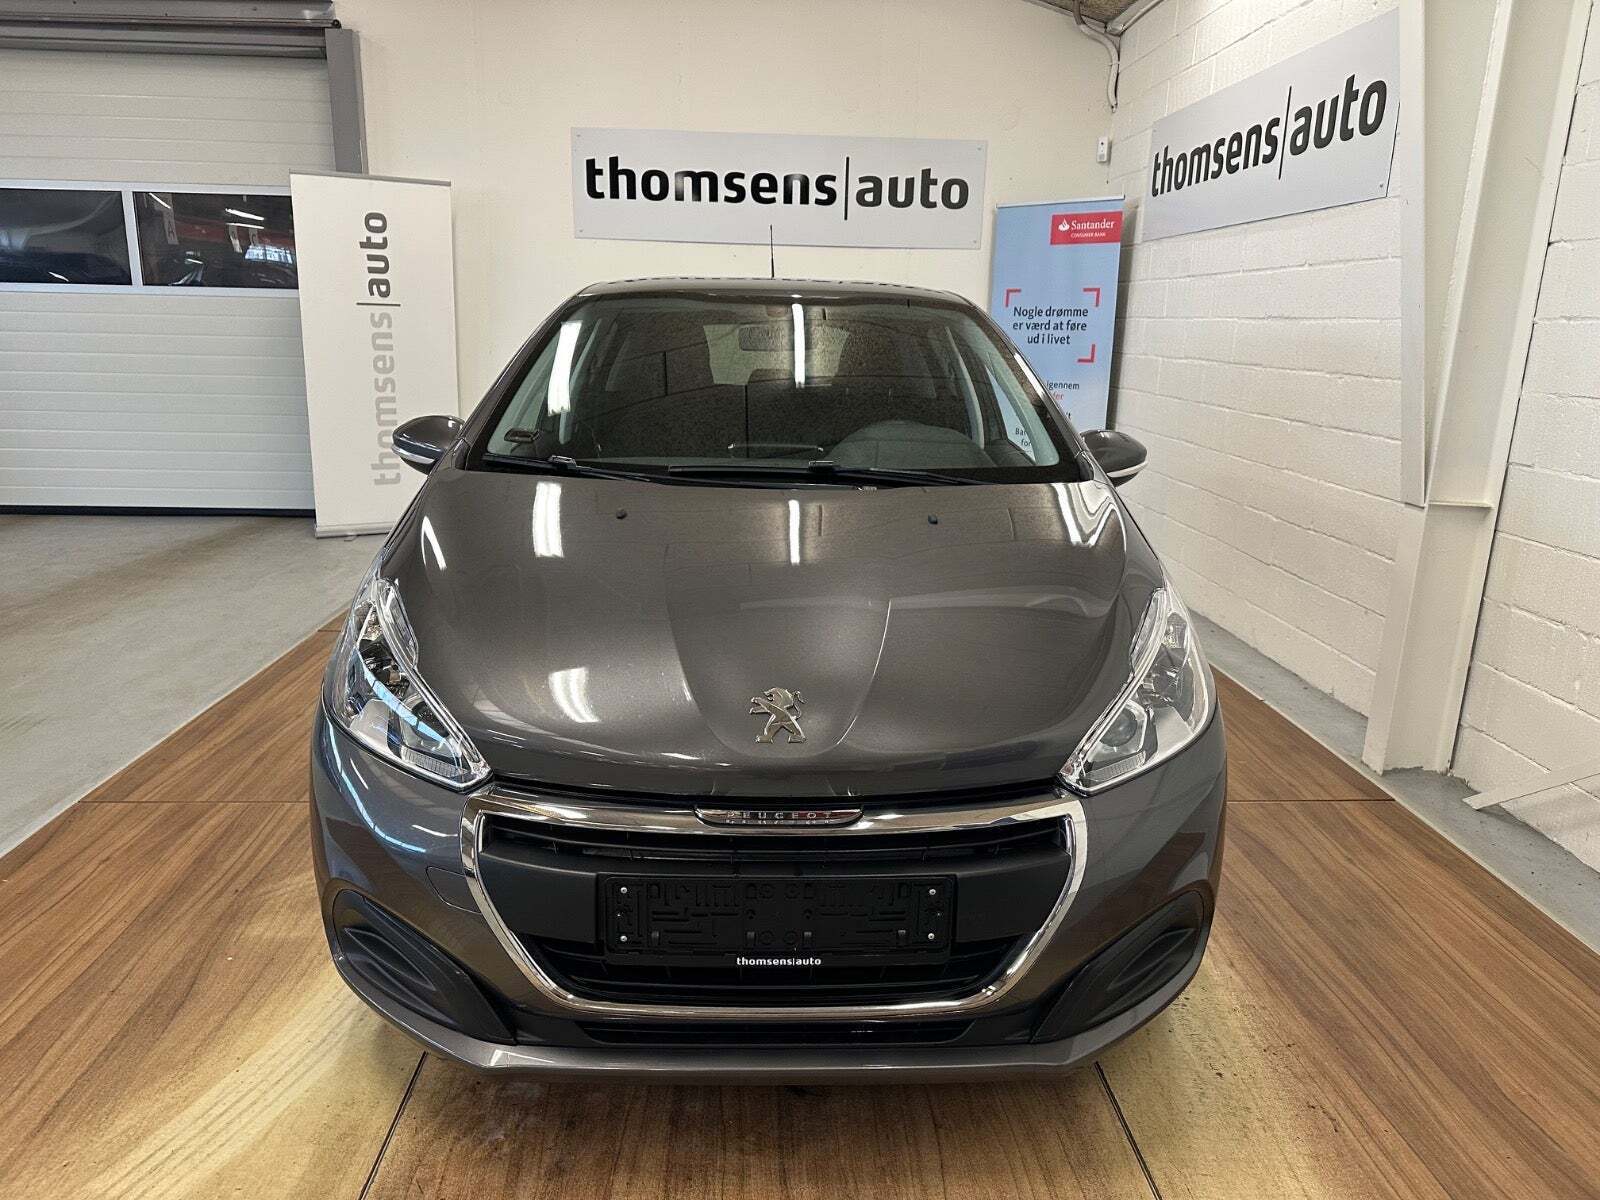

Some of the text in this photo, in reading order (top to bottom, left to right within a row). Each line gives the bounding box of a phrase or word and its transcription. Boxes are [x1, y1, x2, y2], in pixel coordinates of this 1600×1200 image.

[1071, 218, 1115, 230] Santander
[1013, 305, 1089, 319] Nogle drømme
[1012, 319, 1087, 331] er værd at føre
[1027, 333, 1040, 344] ud
[1047, 333, 1071, 345] livet
[726, 810, 832, 820] PEUGEOT
